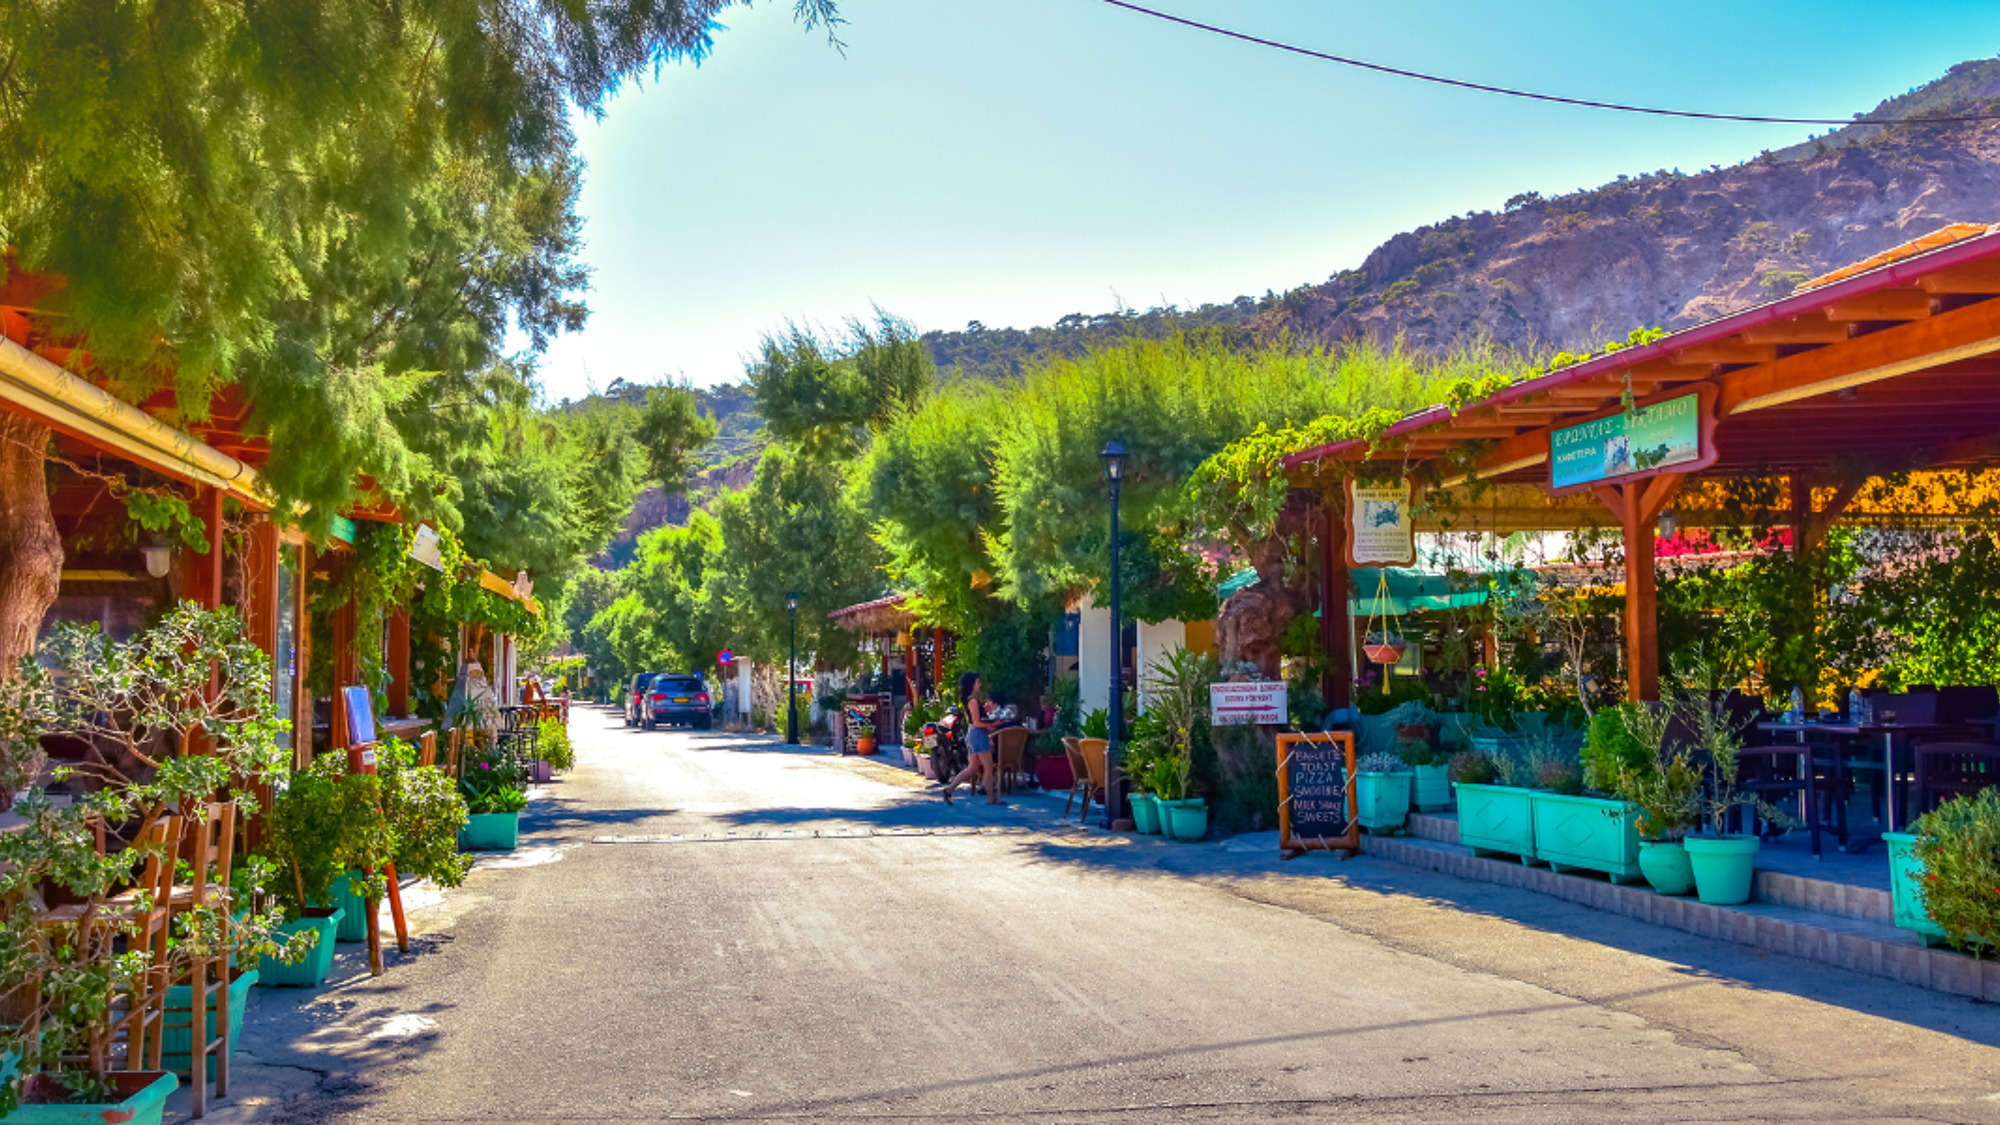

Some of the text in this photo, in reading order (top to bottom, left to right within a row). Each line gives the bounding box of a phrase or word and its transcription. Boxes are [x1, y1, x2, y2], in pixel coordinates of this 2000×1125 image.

[1299, 761, 1336, 772] TOAST
[1295, 771, 1333, 784] PIZZA
[1293, 799, 1316, 811] MILK
[1297, 811, 1341, 824] SWEETS
